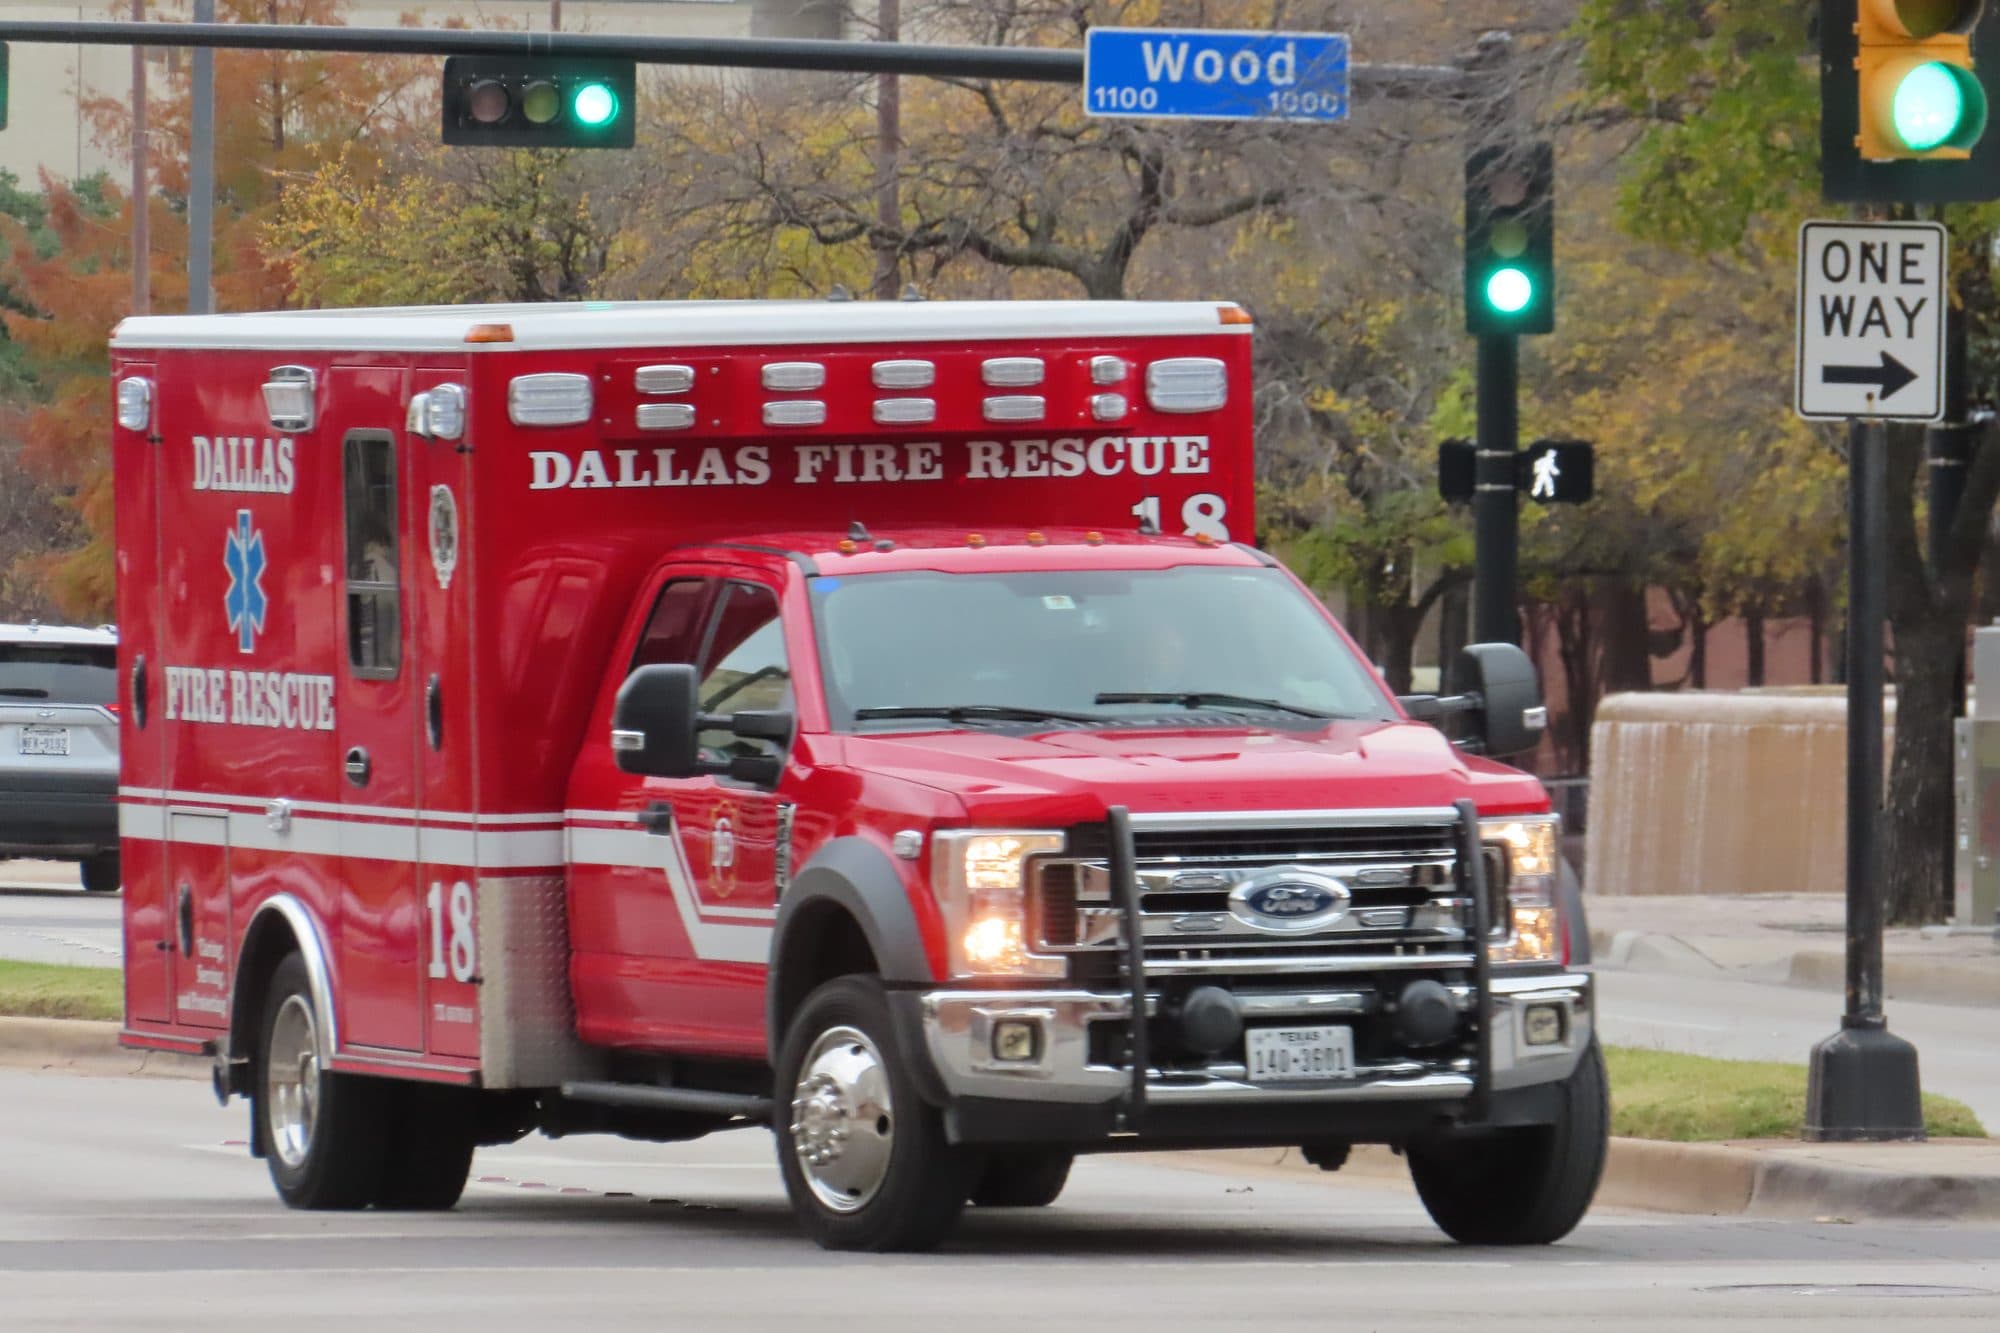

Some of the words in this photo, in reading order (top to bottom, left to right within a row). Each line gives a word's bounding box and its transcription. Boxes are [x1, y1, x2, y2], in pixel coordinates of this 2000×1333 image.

[1141, 41, 1296, 86] Wood
[1094, 87, 1158, 110] 1100
[1268, 91, 1339, 114] 1000
[1821, 239, 1925, 285] ONE
[1819, 294, 1928, 339] WAY
[192, 436, 294, 494] DALLAS
[528, 446, 771, 490] DALLAS
[793, 442, 944, 484] FIRE
[965, 435, 1210, 480] RESCUE
[1131, 493, 1230, 543] 18
[164, 666, 226, 724] FIRE
[229, 669, 336, 731] RESCUE
[1261, 887, 1322, 913] Ford
[427, 880, 475, 983] 18
[1278, 1030, 1321, 1042] TEXAS
